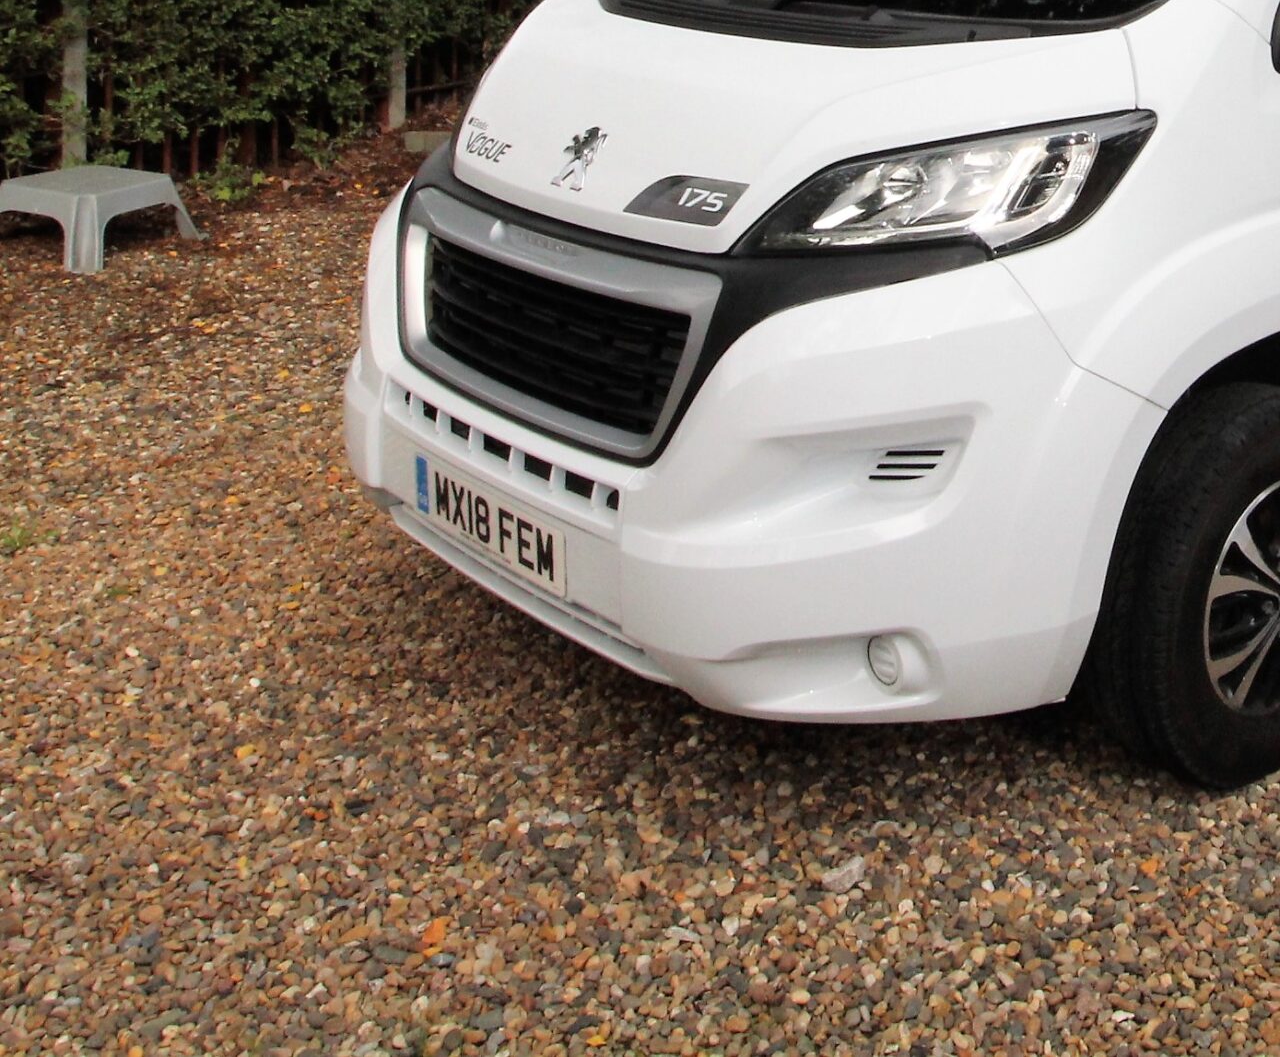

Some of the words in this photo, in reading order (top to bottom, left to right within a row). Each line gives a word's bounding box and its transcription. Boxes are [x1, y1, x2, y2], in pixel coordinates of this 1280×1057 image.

[466, 131, 512, 163] VOGUE
[678, 187, 728, 212] 175
[435, 471, 491, 543] MX18
[498, 506, 554, 582] FEM
